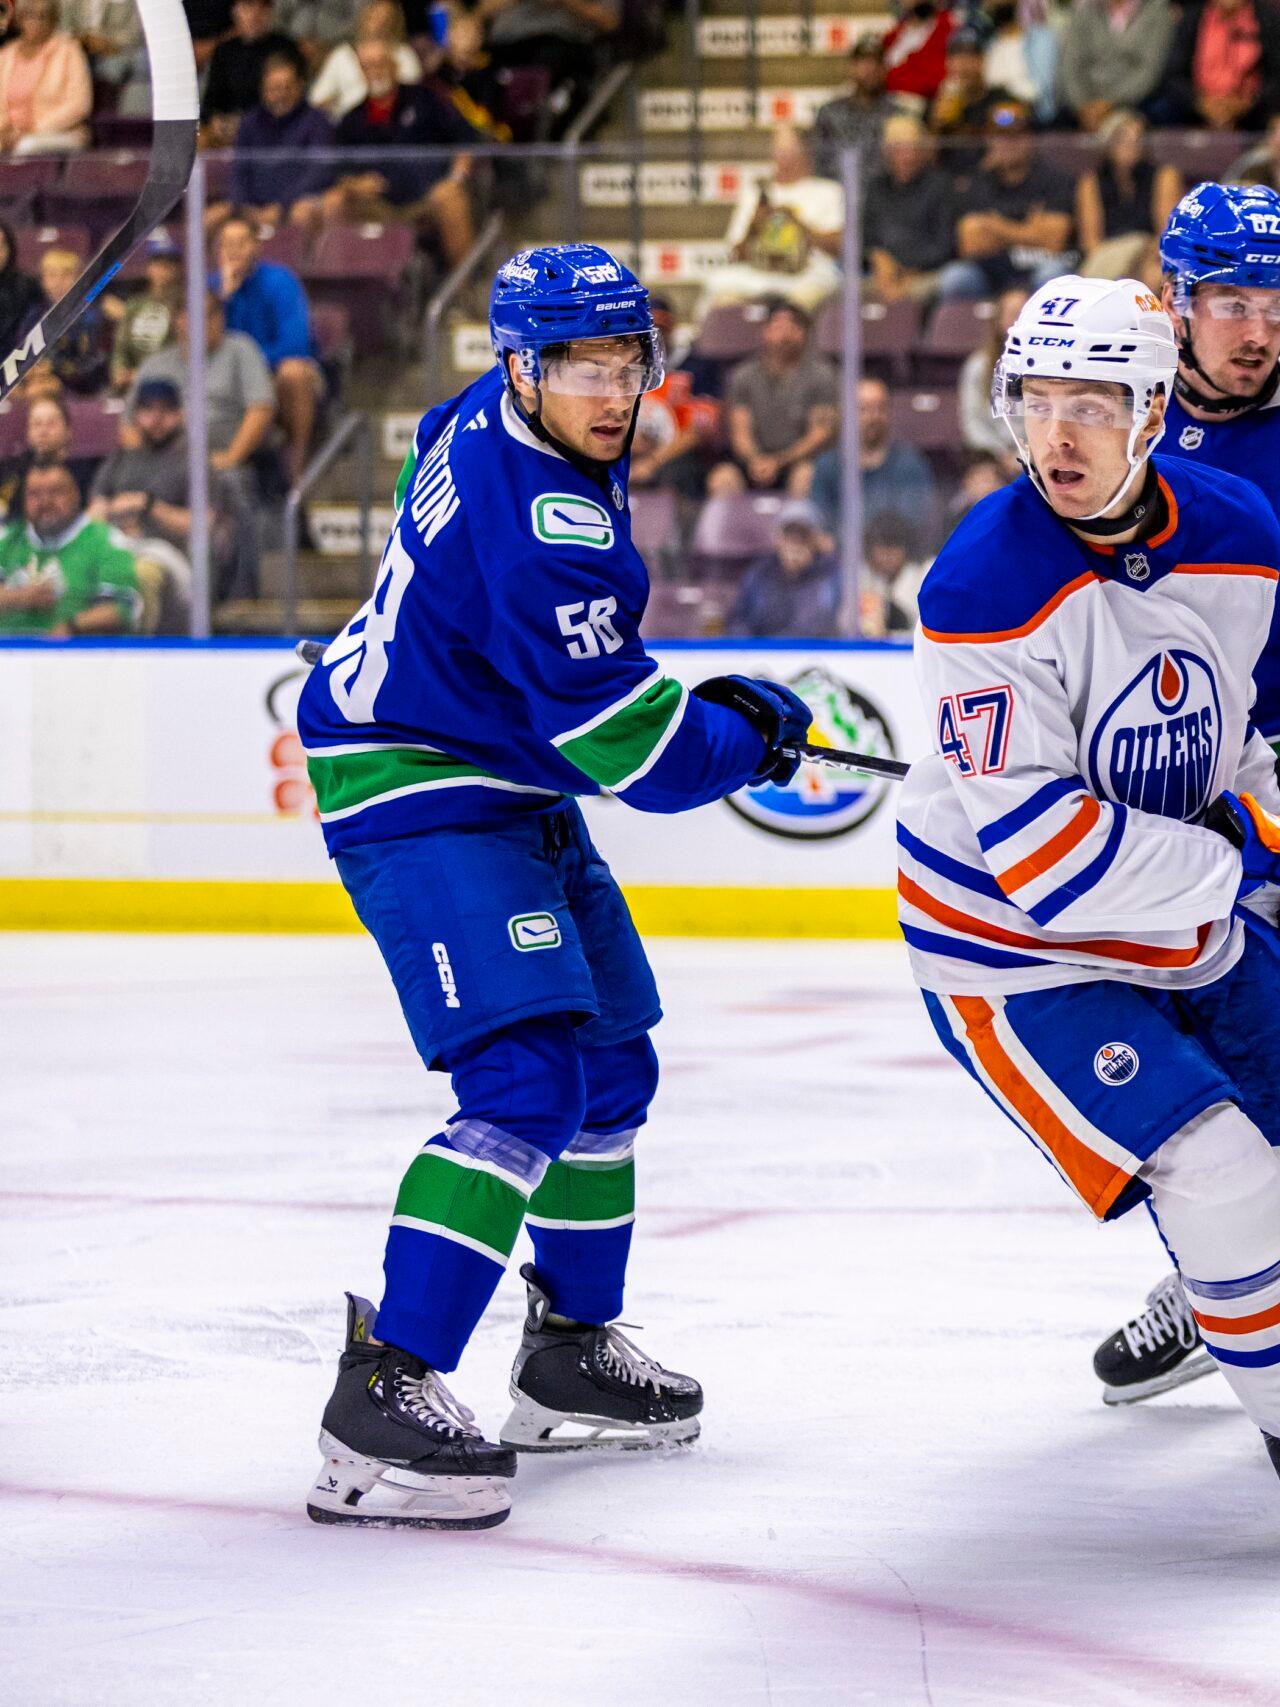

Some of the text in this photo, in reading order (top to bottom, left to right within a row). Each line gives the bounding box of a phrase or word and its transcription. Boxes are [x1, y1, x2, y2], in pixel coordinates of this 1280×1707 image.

[595, 300, 636, 312] BAUER
[1040, 297, 1080, 318] 47
[1029, 336, 1076, 348] CCM
[555, 596, 624, 659] 58
[937, 684, 1014, 778] 47
[1109, 705, 1213, 785] OILERS
[432, 942, 461, 1009] CCM
